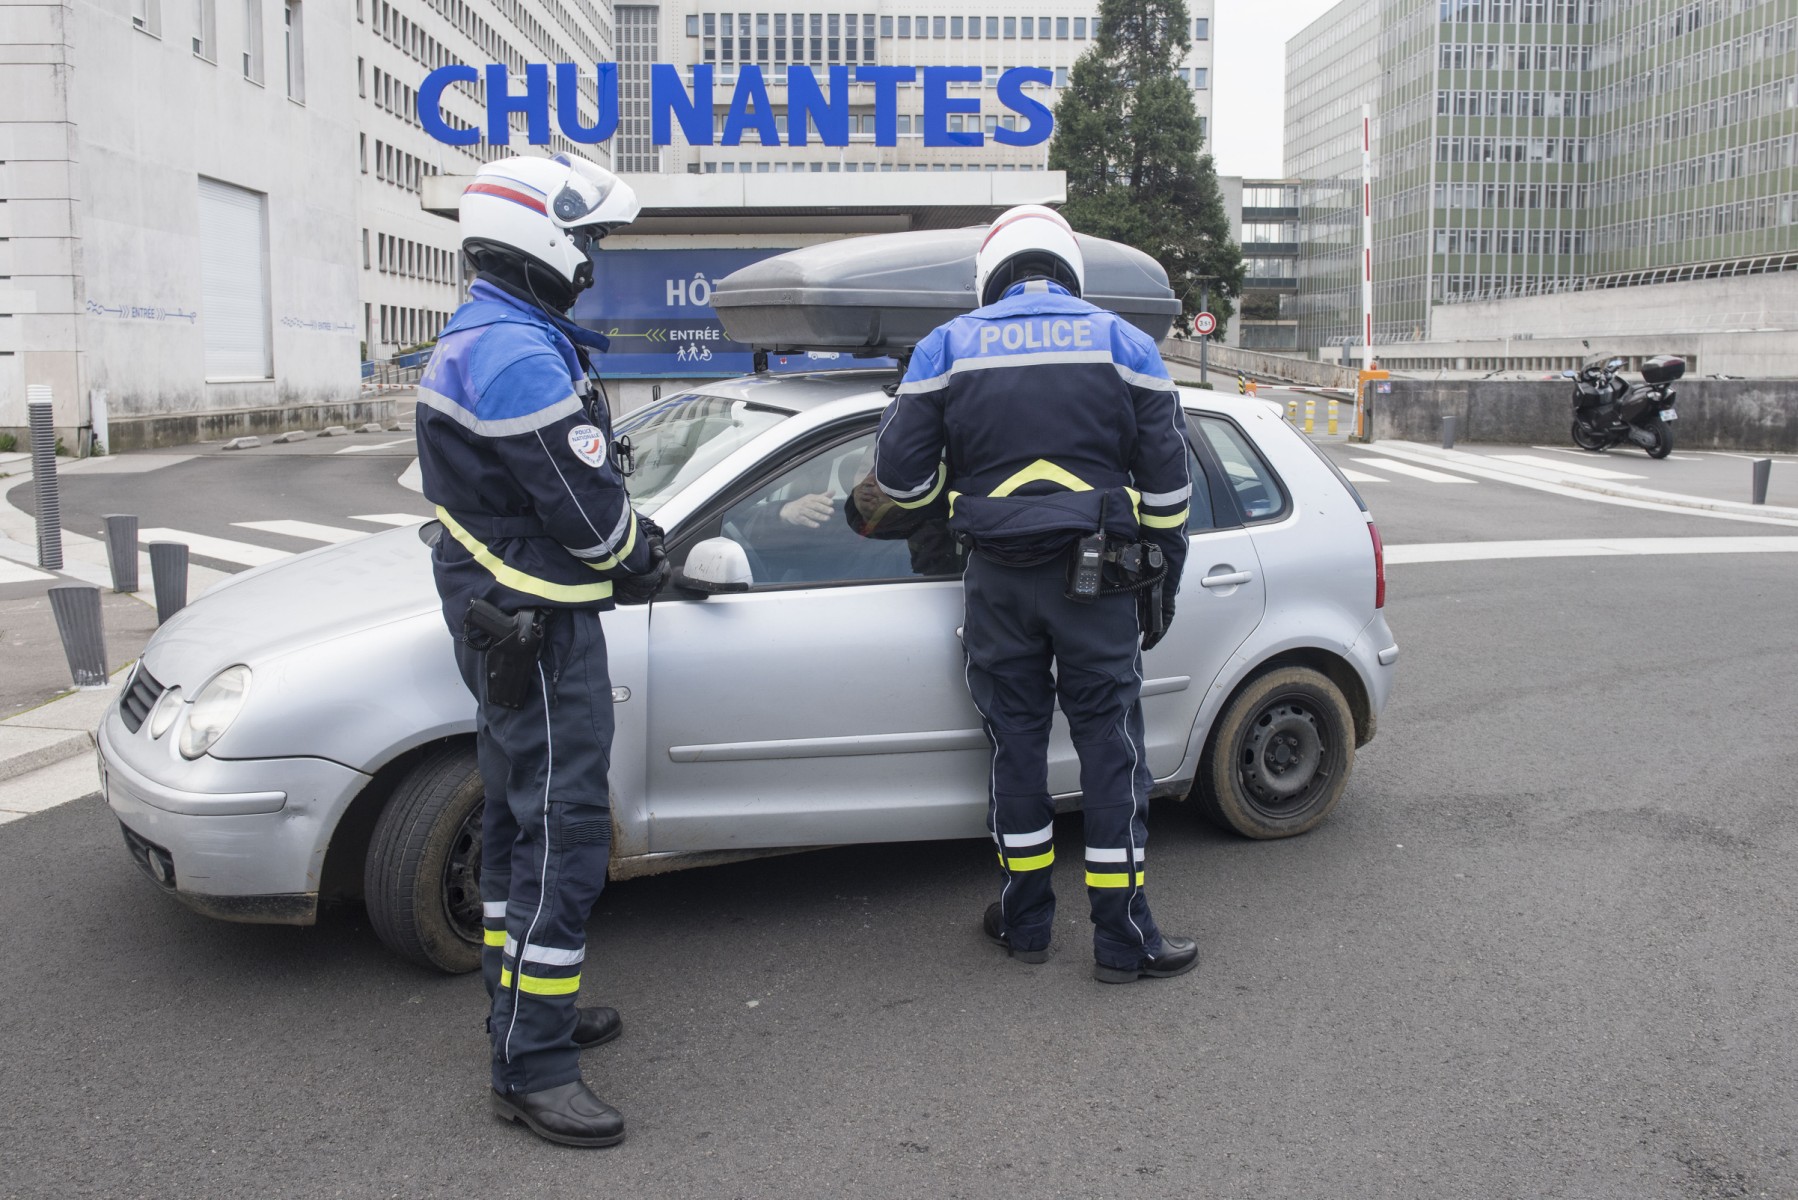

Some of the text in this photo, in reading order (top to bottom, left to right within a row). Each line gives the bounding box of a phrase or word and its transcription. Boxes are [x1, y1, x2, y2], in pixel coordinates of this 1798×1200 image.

[416, 62, 1055, 148] CHU NANTES
[666, 272, 722, 307] HÔ
[669, 326, 720, 341] ENTRÉE
[979, 319, 1093, 354] POLICE
[571, 432, 600, 442] NATIONALE
[574, 428, 592, 436] POLICE
